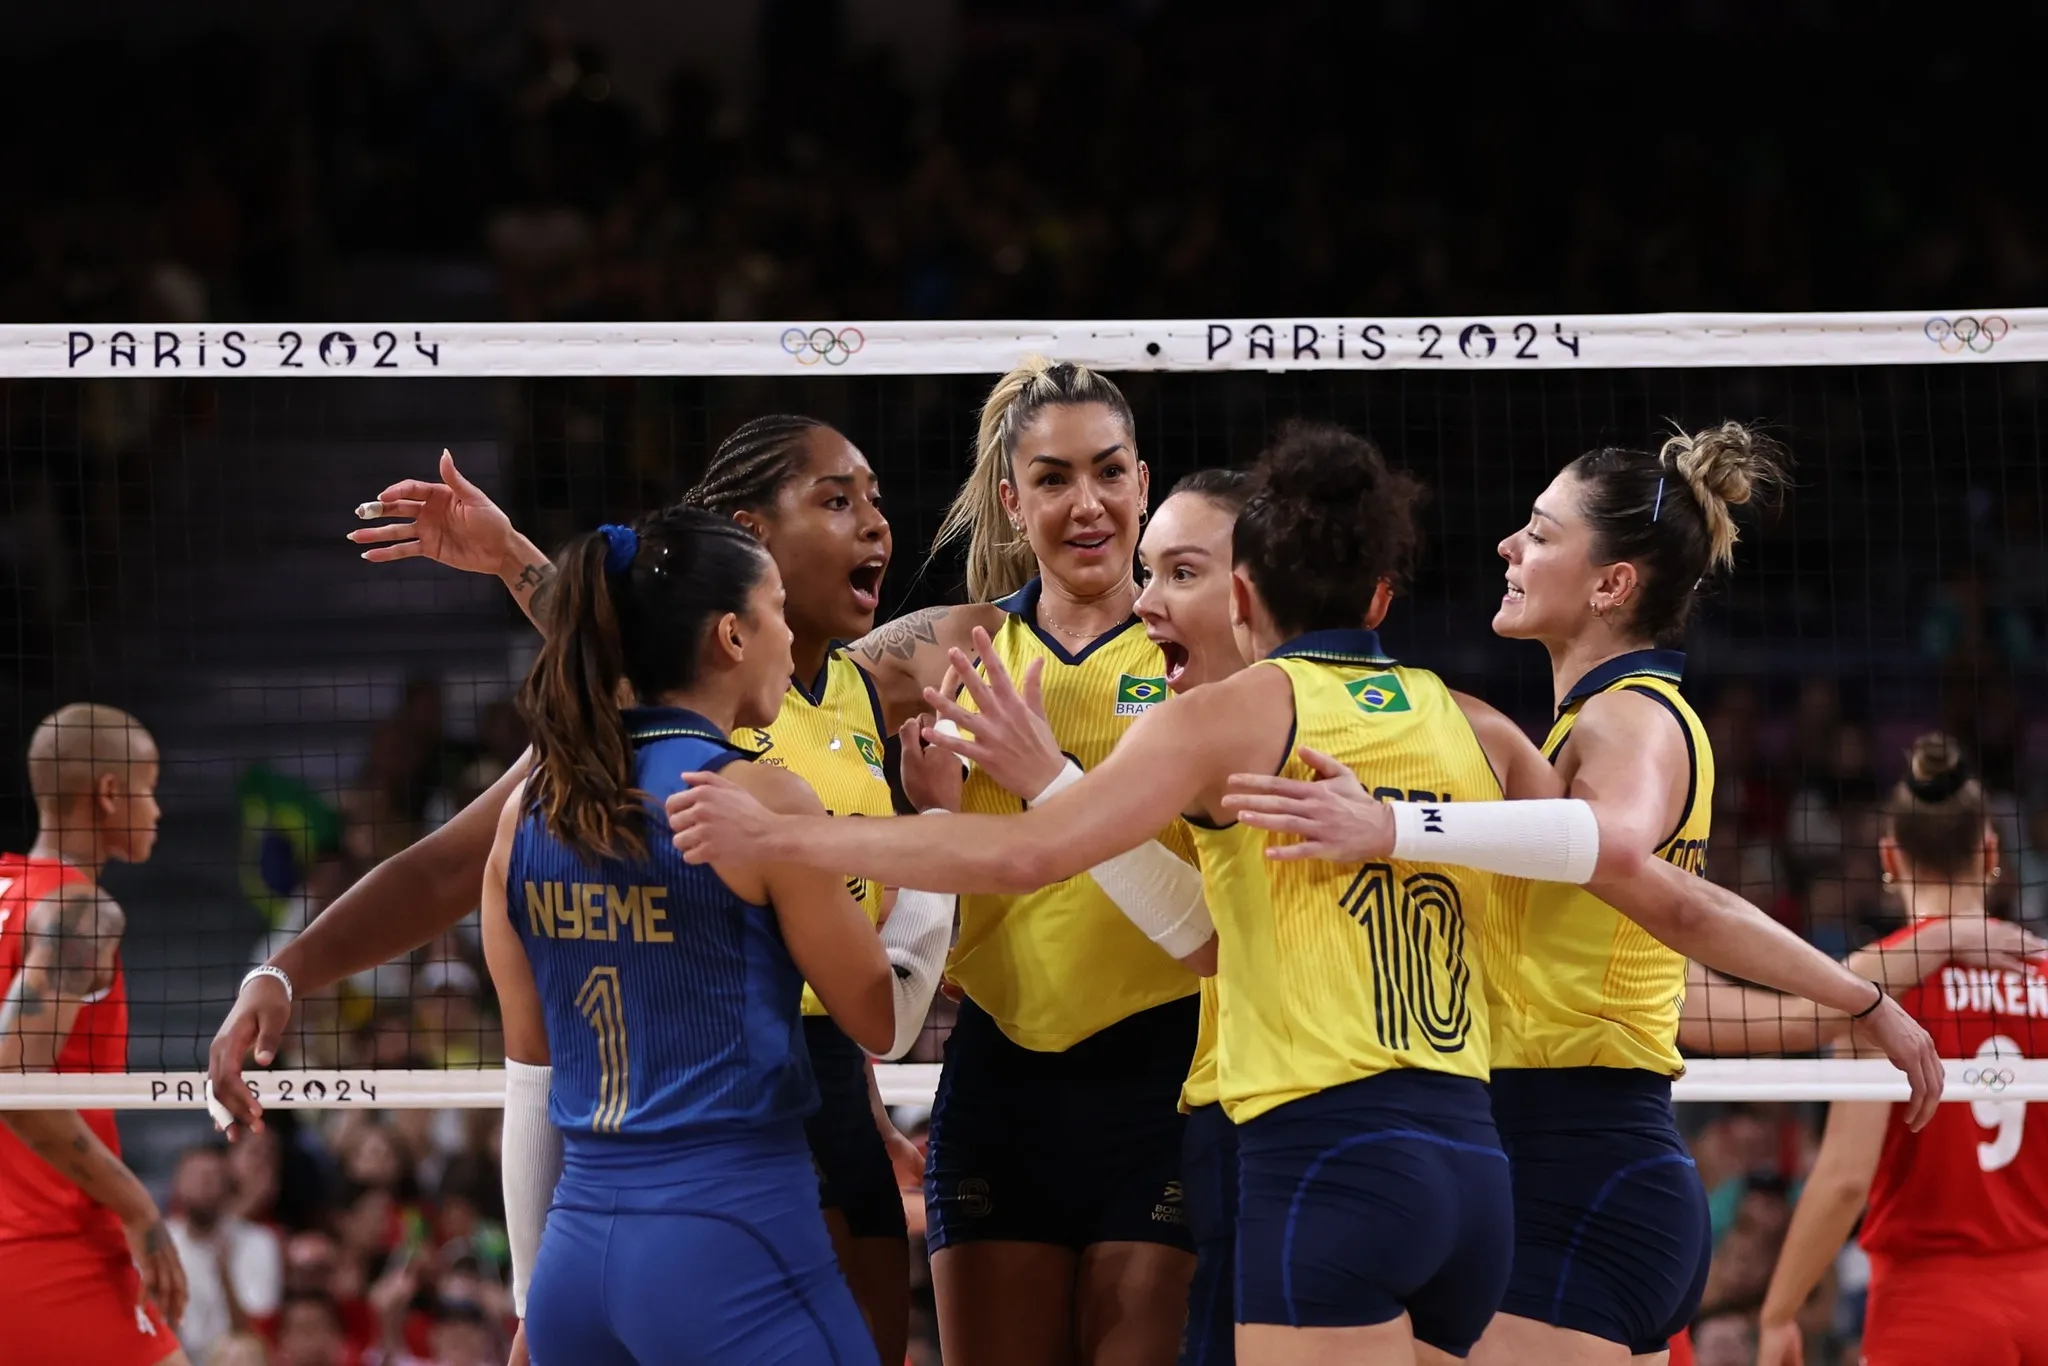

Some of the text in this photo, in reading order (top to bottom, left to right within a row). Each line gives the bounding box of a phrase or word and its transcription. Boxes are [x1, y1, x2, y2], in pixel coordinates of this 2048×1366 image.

[278, 330, 439, 368] 2024
[1417, 322, 1580, 360] 2024
[524, 880, 675, 943] NYEME
[1338, 862, 1471, 1053] 10
[574, 965, 629, 1133] 1
[152, 1079, 376, 1101] PAS 2024
[1154, 1203, 1182, 1215] BOD
